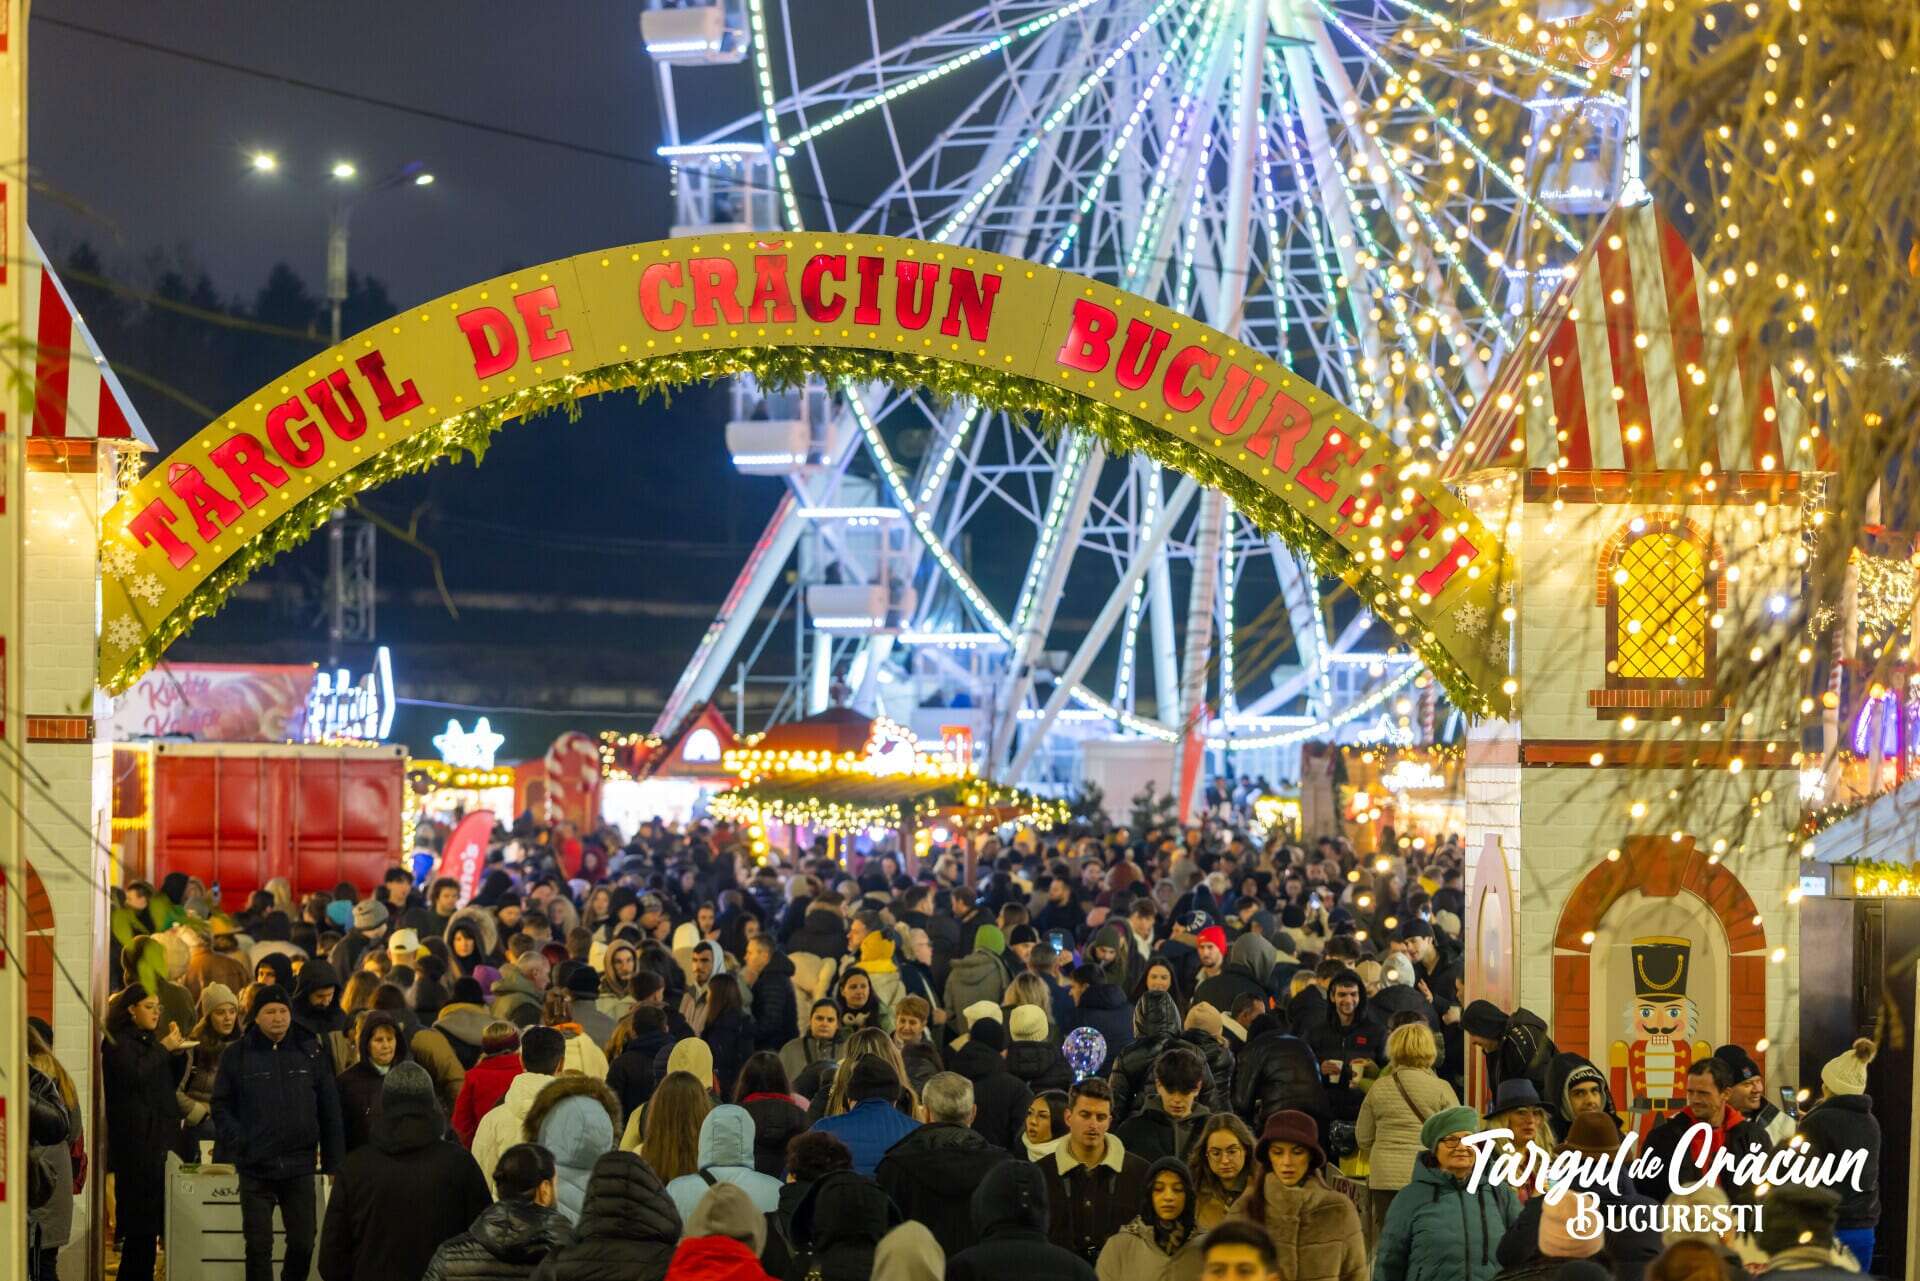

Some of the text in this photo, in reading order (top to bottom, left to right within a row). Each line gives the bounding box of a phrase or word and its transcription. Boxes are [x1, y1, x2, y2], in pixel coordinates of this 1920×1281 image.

[128, 349, 424, 570] TÂRGUL
[456, 285, 573, 380] DE
[639, 240, 1002, 342] CRĂCIUN
